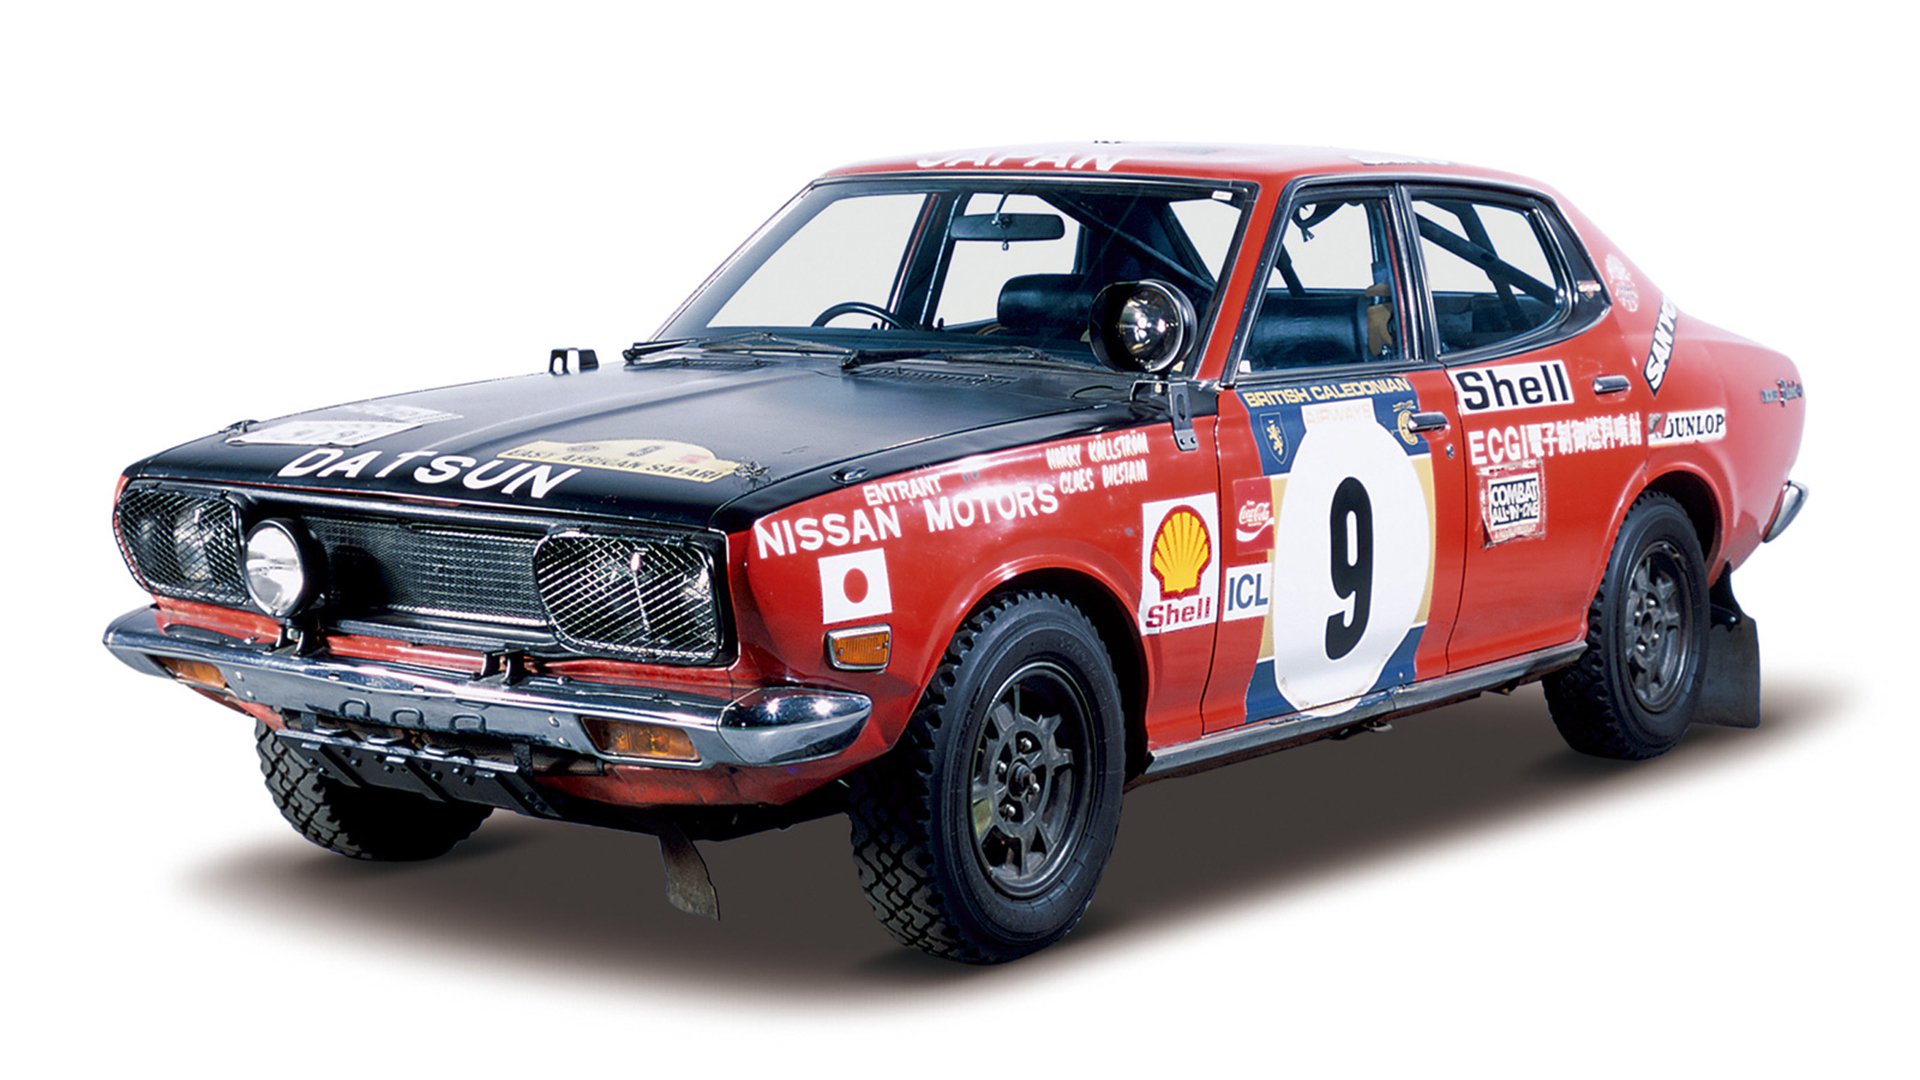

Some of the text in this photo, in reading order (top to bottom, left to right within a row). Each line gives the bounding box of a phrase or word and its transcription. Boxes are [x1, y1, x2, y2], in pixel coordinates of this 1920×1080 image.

[1242, 378, 1412, 408] BRITISH CALEDONIAN
[1455, 363, 1569, 410] Shell
[1045, 443, 1082, 470] HARRY
[276, 448, 582, 499] DATSUN
[1060, 467, 1095, 494] CLAES
[863, 475, 942, 506] ENTRANT
[1490, 482, 1538, 508] COMBAT
[754, 482, 1059, 559] NISSAN MOTORS
[1325, 476, 1373, 660] 9
[1227, 573, 1269, 612] ICL
[1145, 596, 1211, 629] Shell
